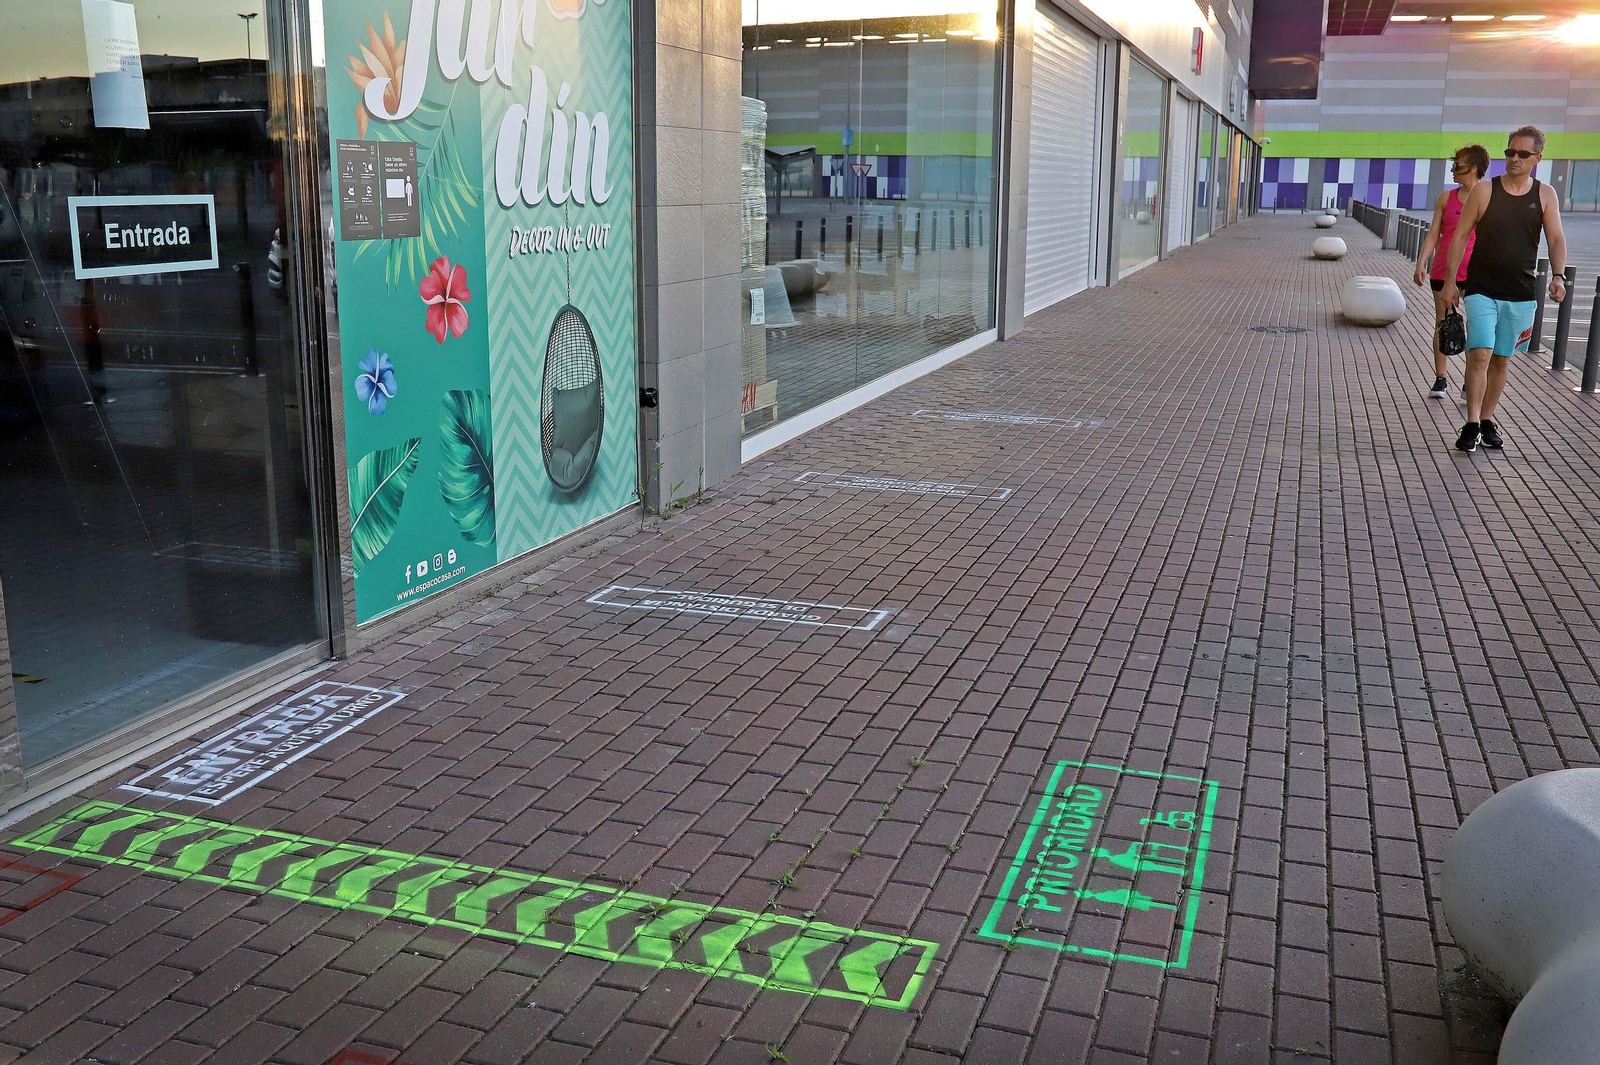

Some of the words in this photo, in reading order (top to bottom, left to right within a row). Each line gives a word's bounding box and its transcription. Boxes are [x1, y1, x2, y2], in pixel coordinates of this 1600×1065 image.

[104, 221, 190, 249] Entrada
[510, 225, 555, 258] DECOR
[557, 225, 572, 251] IN
[573, 224, 584, 251] &
[586, 223, 611, 250] OUT
[396, 566, 466, 601] www.espacocasa.com
[303, 722, 333, 736] SU
[331, 694, 383, 722] TURNO
[161, 694, 354, 786] ENTRADA
[1018, 784, 1102, 913] PRIORIDAD
